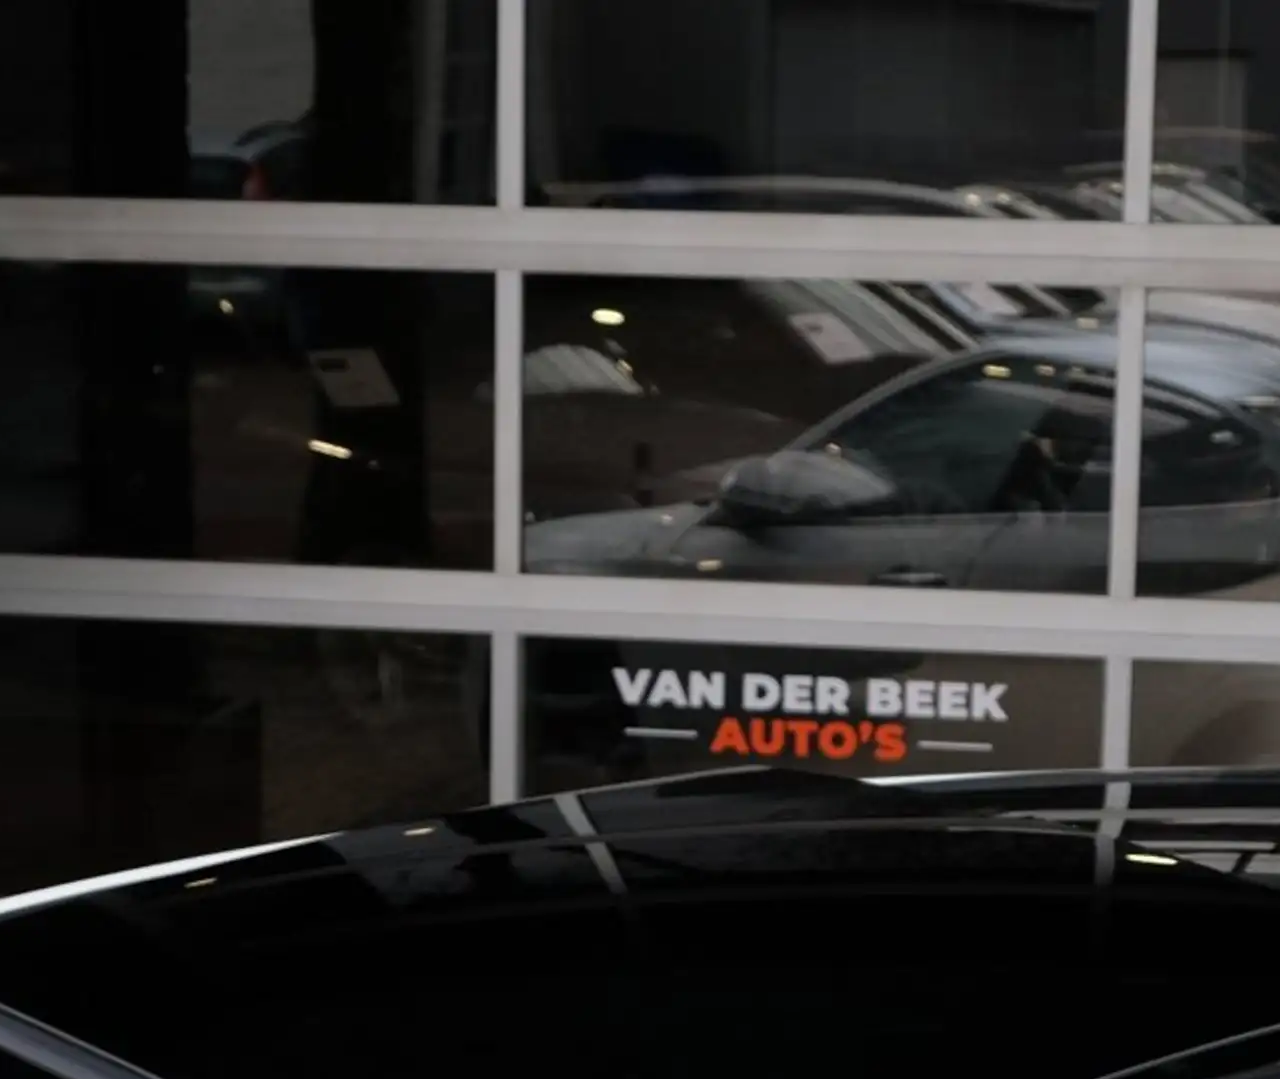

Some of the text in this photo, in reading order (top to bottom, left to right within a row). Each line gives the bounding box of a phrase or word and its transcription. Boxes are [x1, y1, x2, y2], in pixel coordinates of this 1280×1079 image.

[611, 667, 1009, 722] VAN DER BEEK
[710, 716, 908, 762] AUTO'S
